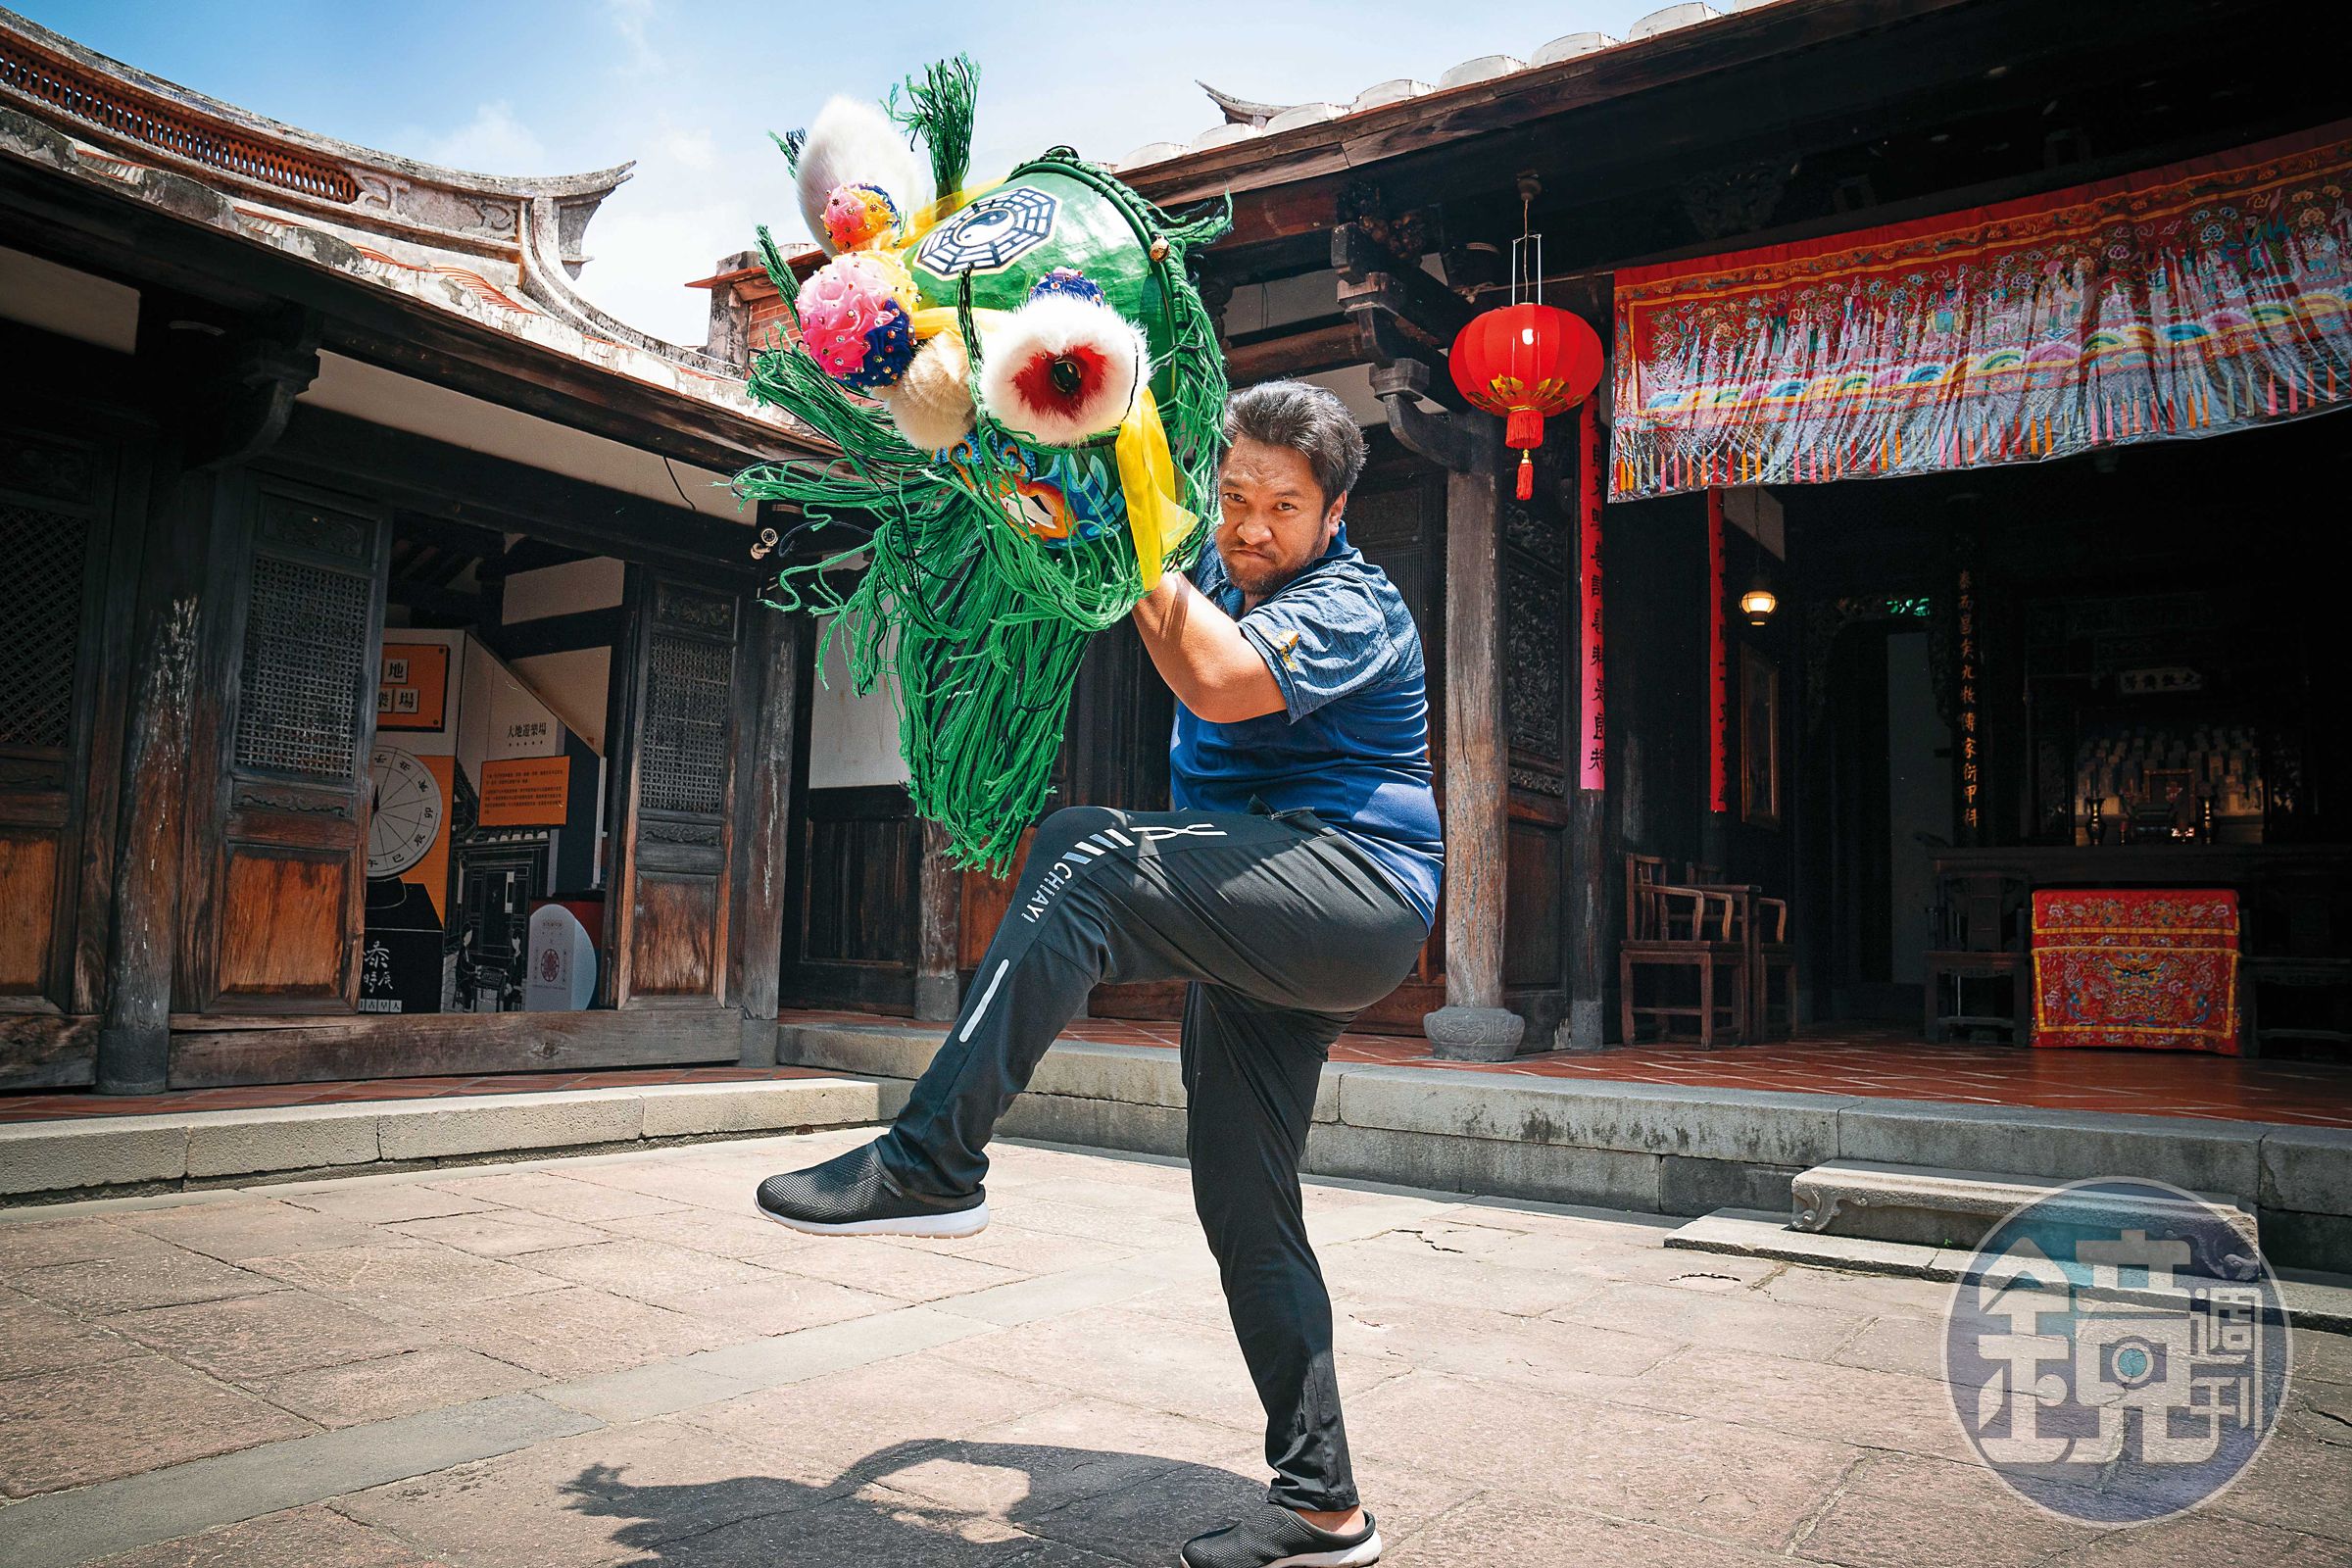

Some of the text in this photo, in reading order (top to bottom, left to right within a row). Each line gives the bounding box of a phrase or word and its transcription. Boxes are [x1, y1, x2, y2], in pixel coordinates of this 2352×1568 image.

[388, 662, 404, 678] 地
[507, 722, 547, 738] 大地遊樂場
[373, 754, 387, 763] 子
[399, 760, 411, 771] 丑
[424, 807, 434, 819] 卯
[414, 833, 426, 847] 辰
[1021, 861, 1073, 923] CHIAYI
[363, 940, 390, 968] 泰
